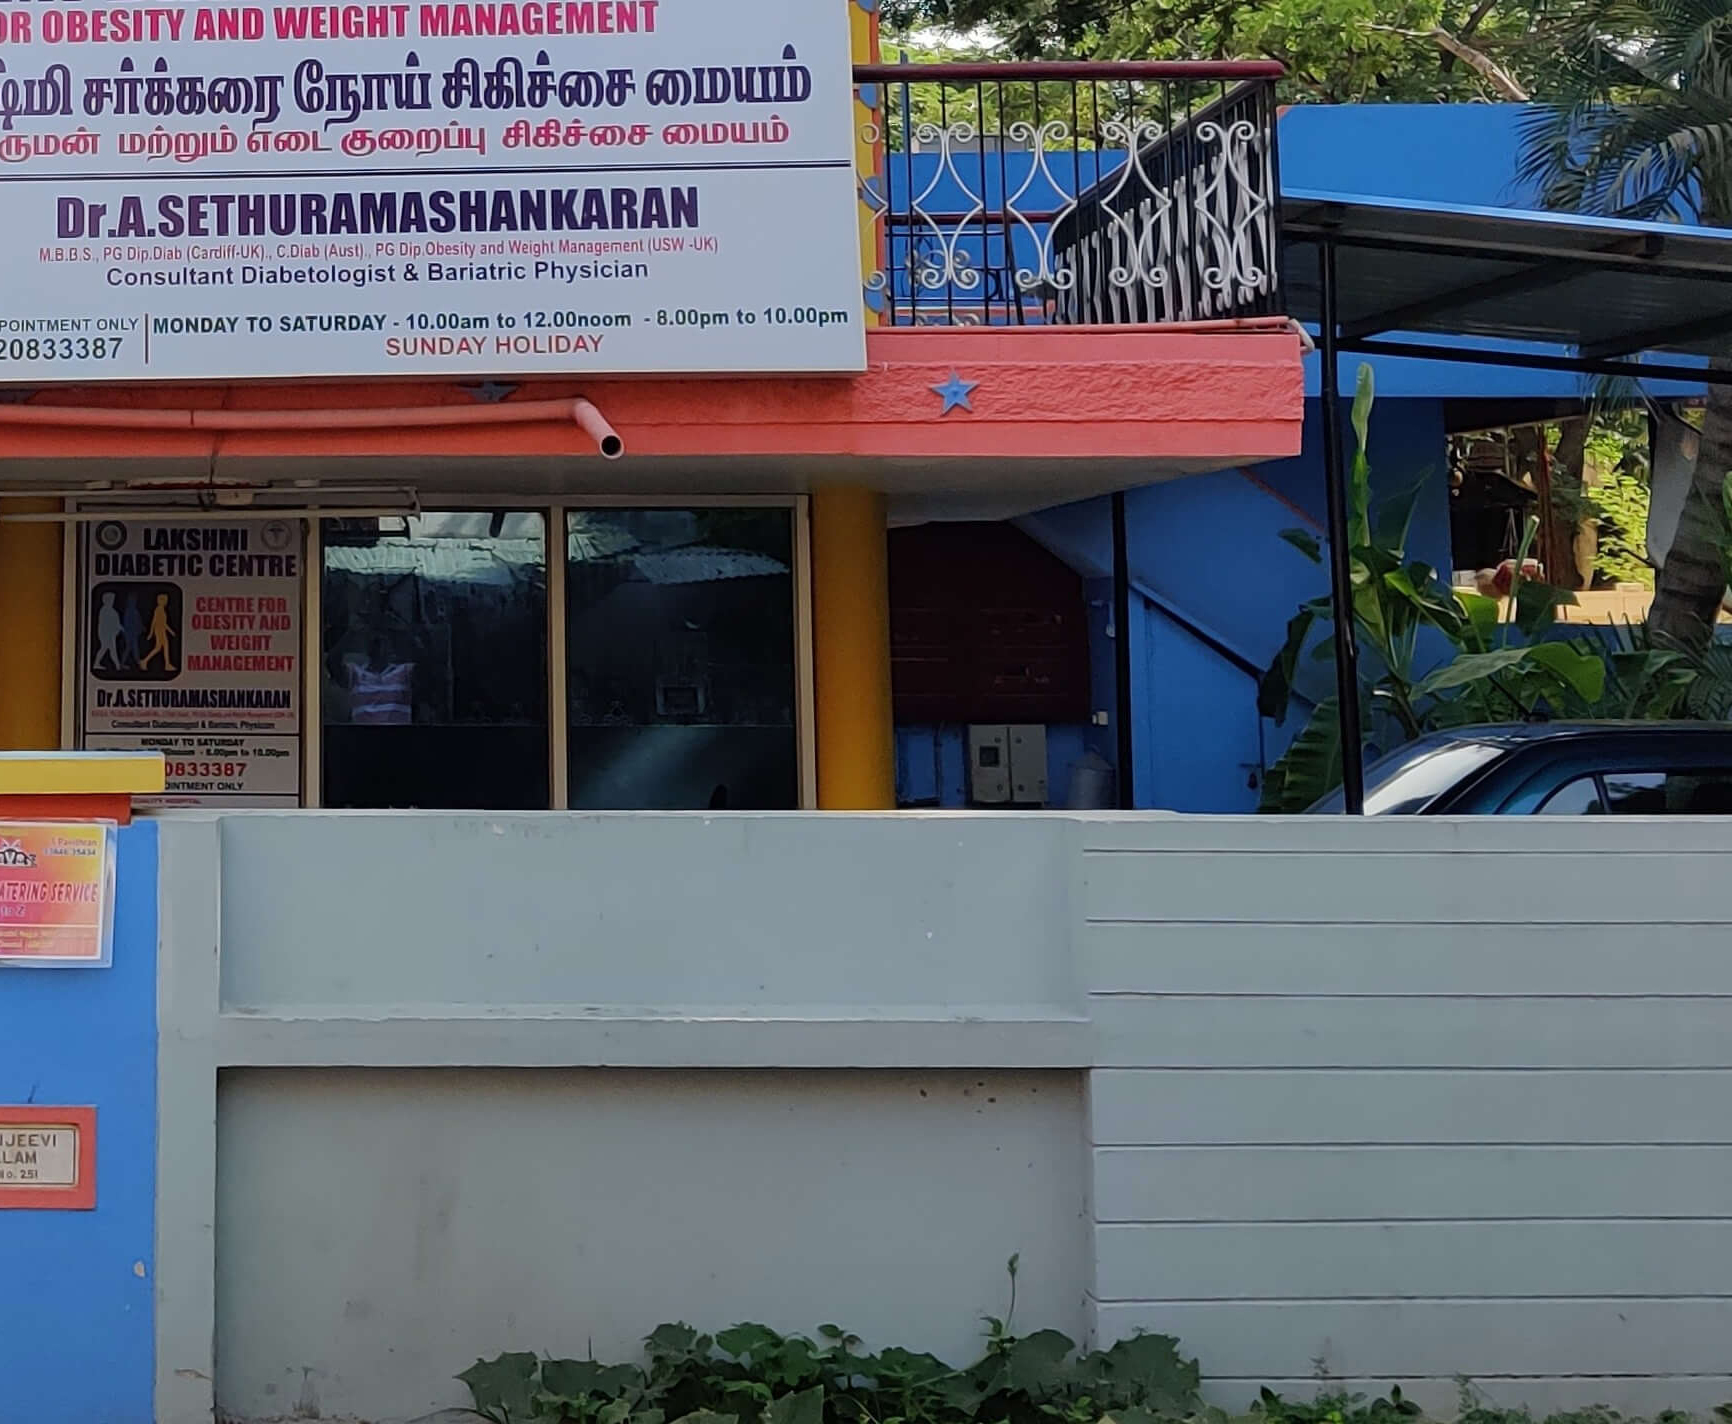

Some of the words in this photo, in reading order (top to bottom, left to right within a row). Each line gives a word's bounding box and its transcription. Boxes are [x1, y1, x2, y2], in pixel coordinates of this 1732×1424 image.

[42, 7, 185, 43] OBESITY
[194, 7, 265, 41] AND
[273, 4, 411, 40] WEIGHT
[419, 0, 659, 37] MANAGEMENT
[293, 51, 433, 132] நோய்
[442, 48, 637, 110] சிகிச்சை
[645, 43, 812, 107] மையம்
[117, 125, 238, 163] மற்றும்
[246, 130, 332, 156] எடை
[340, 120, 487, 158] குறைப்பு
[501, 117, 653, 149] சிகிச்சை
[662, 114, 789, 145] மையம்
[56, 185, 699, 239] Dr.A.SETHURAMASHANKARAN
[103, 246, 122, 262] PG
[127, 245, 182, 264] Dip.Diab
[276, 243, 320, 259] C.Diab
[375, 242, 396, 257] PG
[480, 240, 505, 256] and
[508, 239, 556, 258] Weight
[558, 238, 645, 258] Management
[647, 237, 685, 254] (USW
[106, 266, 234, 286] Consultant
[241, 263, 396, 288] Diabetologist
[403, 262, 420, 282] &
[427, 261, 526, 282] Bariatric
[534, 260, 649, 284] Physician
[96, 317, 139, 332] ONLY
[153, 316, 239, 334] MONDAY
[246, 316, 273, 333] TO
[279, 314, 388, 333] SATURDAY
[405, 312, 491, 331] 10.00am
[497, 312, 517, 329] to
[523, 311, 632, 328] 12.00noom
[656, 308, 730, 329] 8.00pm
[737, 309, 757, 325] to
[763, 307, 849, 328] 10.00pm
[386, 335, 488, 356] SUNDAY
[495, 334, 605, 355] HOLIDAY
[143, 527, 248, 551] LAKSHMI
[95, 553, 204, 576] DIABETIC
[209, 553, 297, 577] CENTRE
[195, 596, 254, 613] CENTRE
[258, 596, 287, 613] FOR
[191, 615, 257, 631] OBESITY
[260, 615, 292, 631] AND
[210, 634, 272, 651] WEIGHT
[186, 655, 295, 672] MANAGEMENT
[141, 738, 179, 747] MONDAY
[182, 738, 194, 747] TO
[197, 738, 245, 747] SATURDAY
[217, 782, 244, 791] ONLY
[50, 882, 99, 903] SERVICE
[20, 1169, 38, 1180] 251
